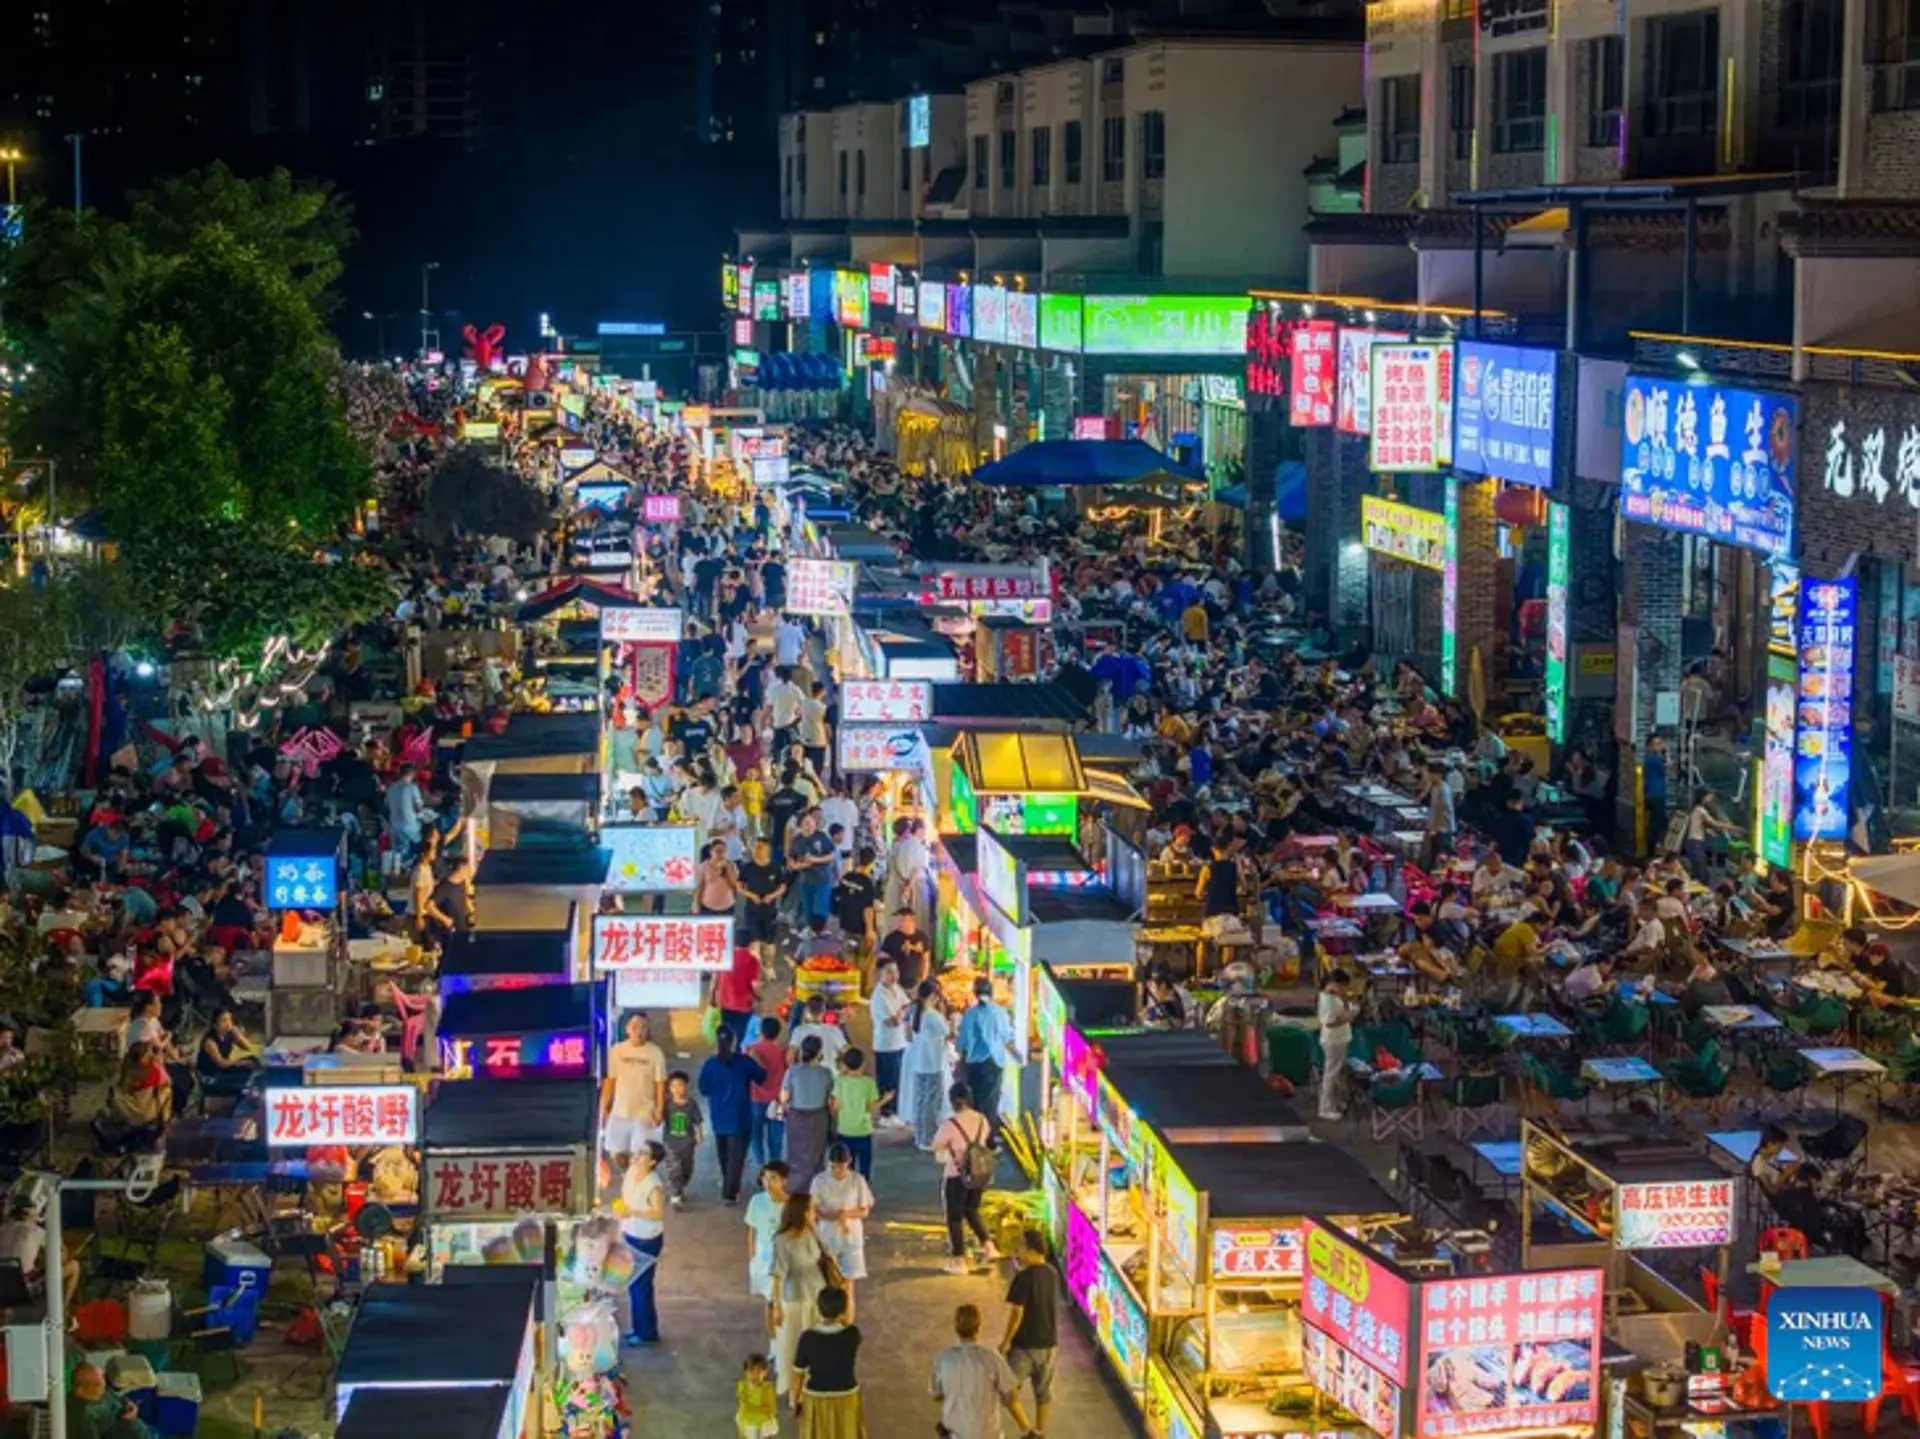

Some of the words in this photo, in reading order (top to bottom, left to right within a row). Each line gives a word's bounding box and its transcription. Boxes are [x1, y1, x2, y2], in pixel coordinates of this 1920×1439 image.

[600, 921, 727, 965] 龙圩酸嘢
[272, 1093, 410, 1138] 龙圩酸嘢
[434, 1160, 572, 1210] 龙圩酸嘢
